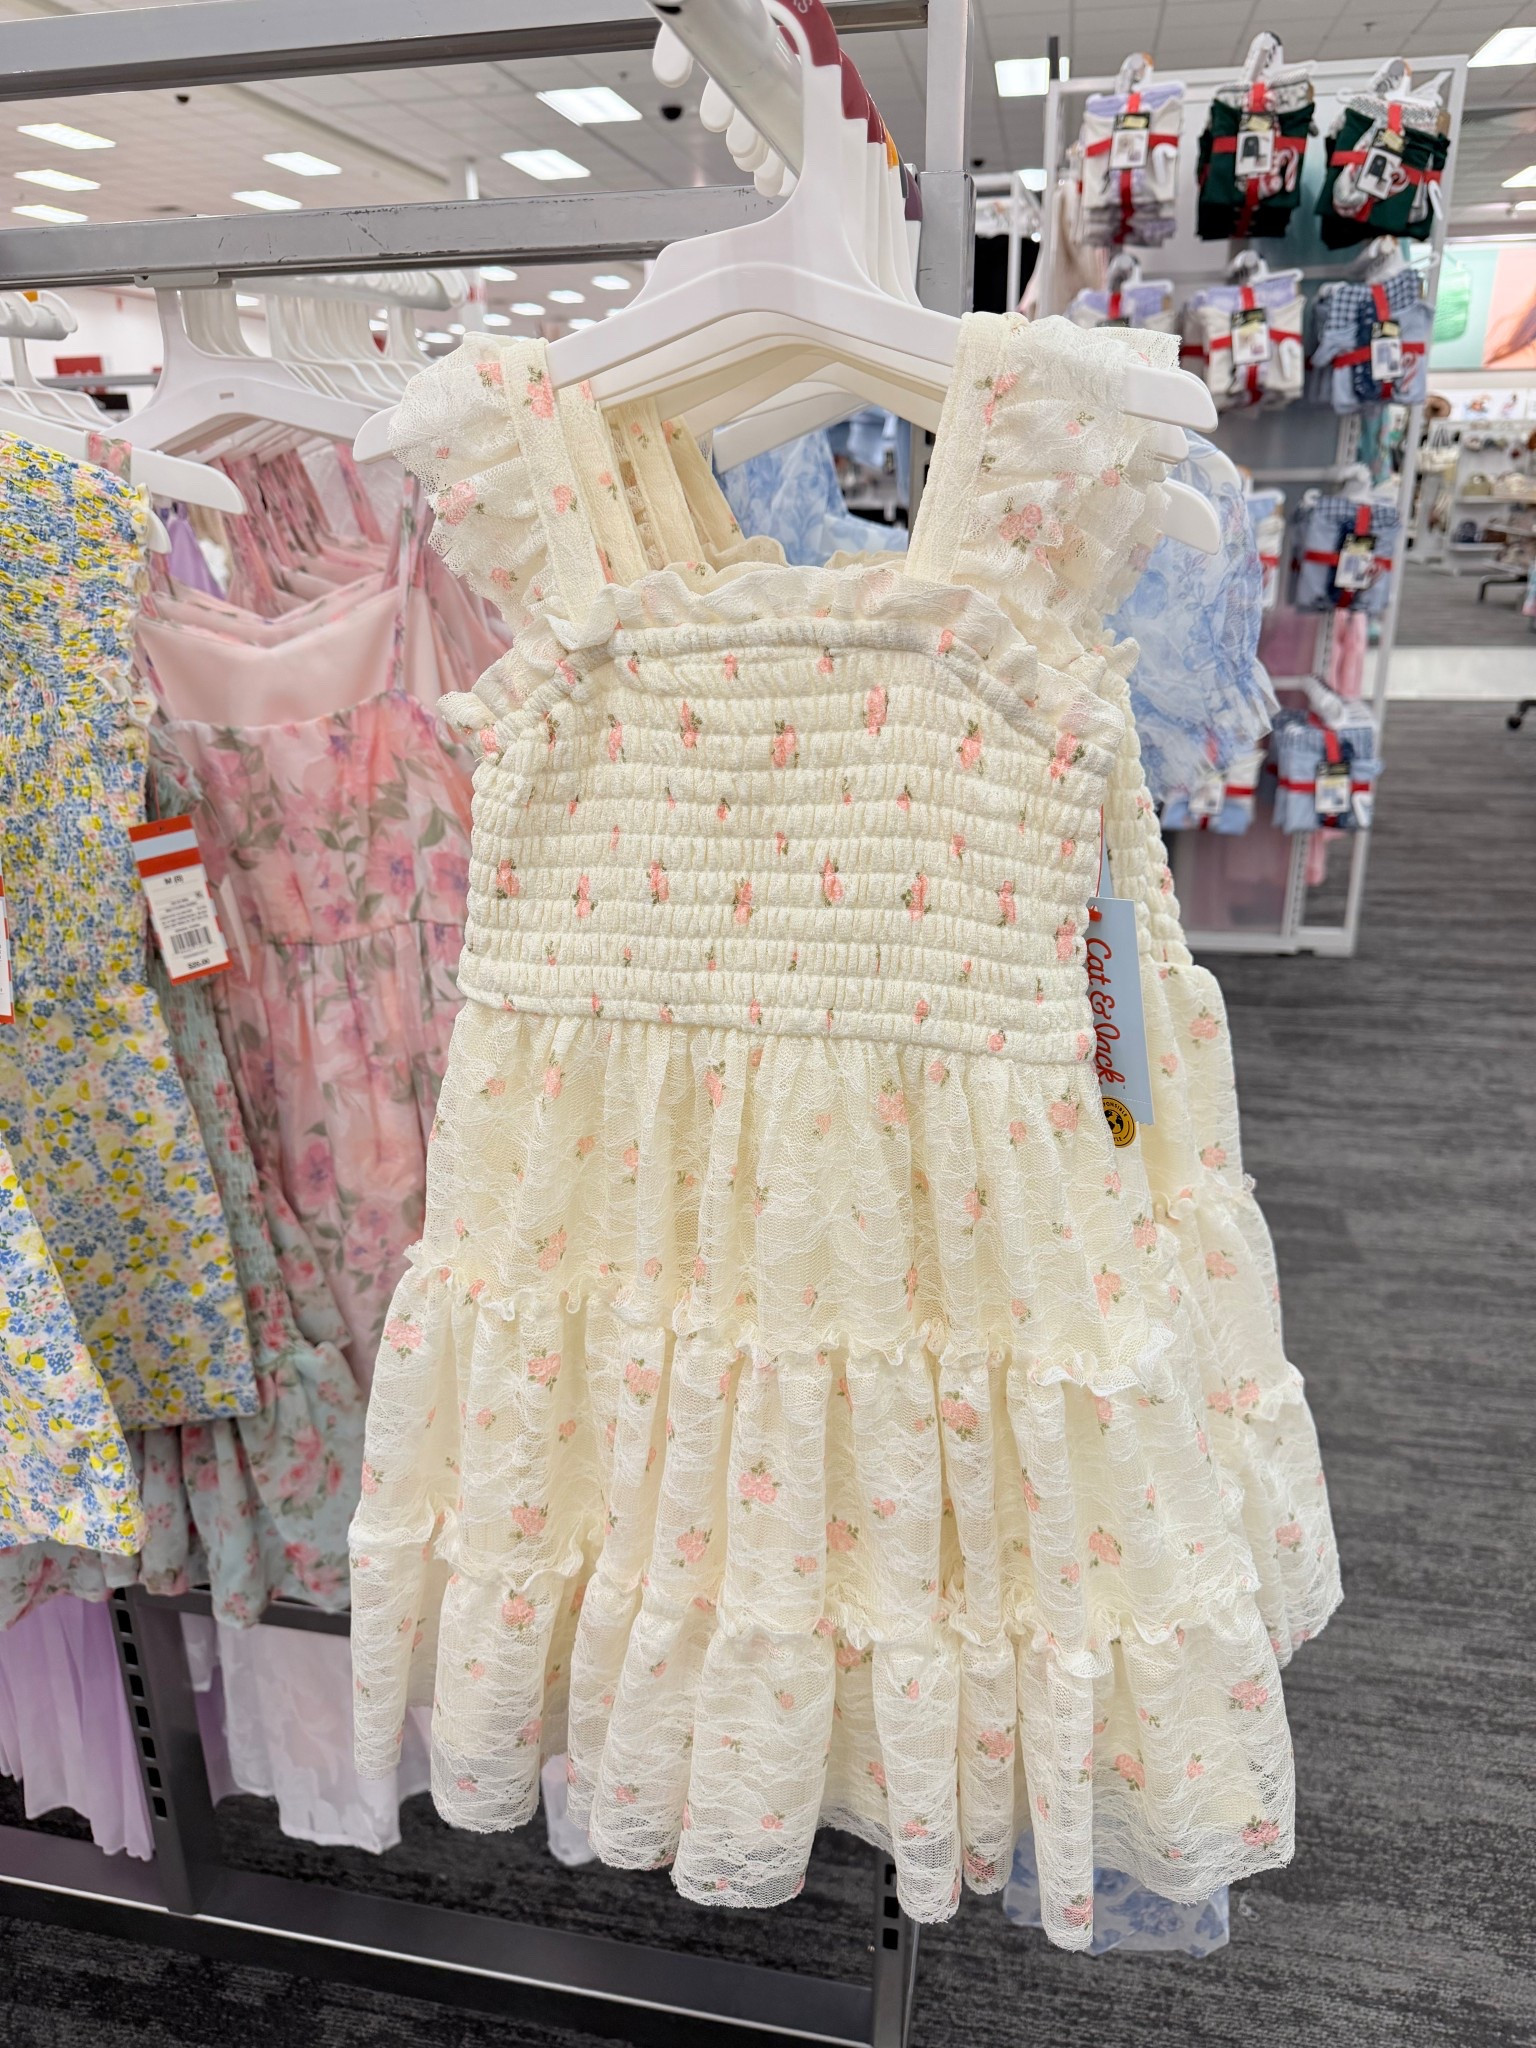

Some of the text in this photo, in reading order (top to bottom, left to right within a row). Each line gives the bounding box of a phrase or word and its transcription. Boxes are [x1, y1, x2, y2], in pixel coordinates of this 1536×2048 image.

[1086, 937, 1126, 1086] Cat & Jack
